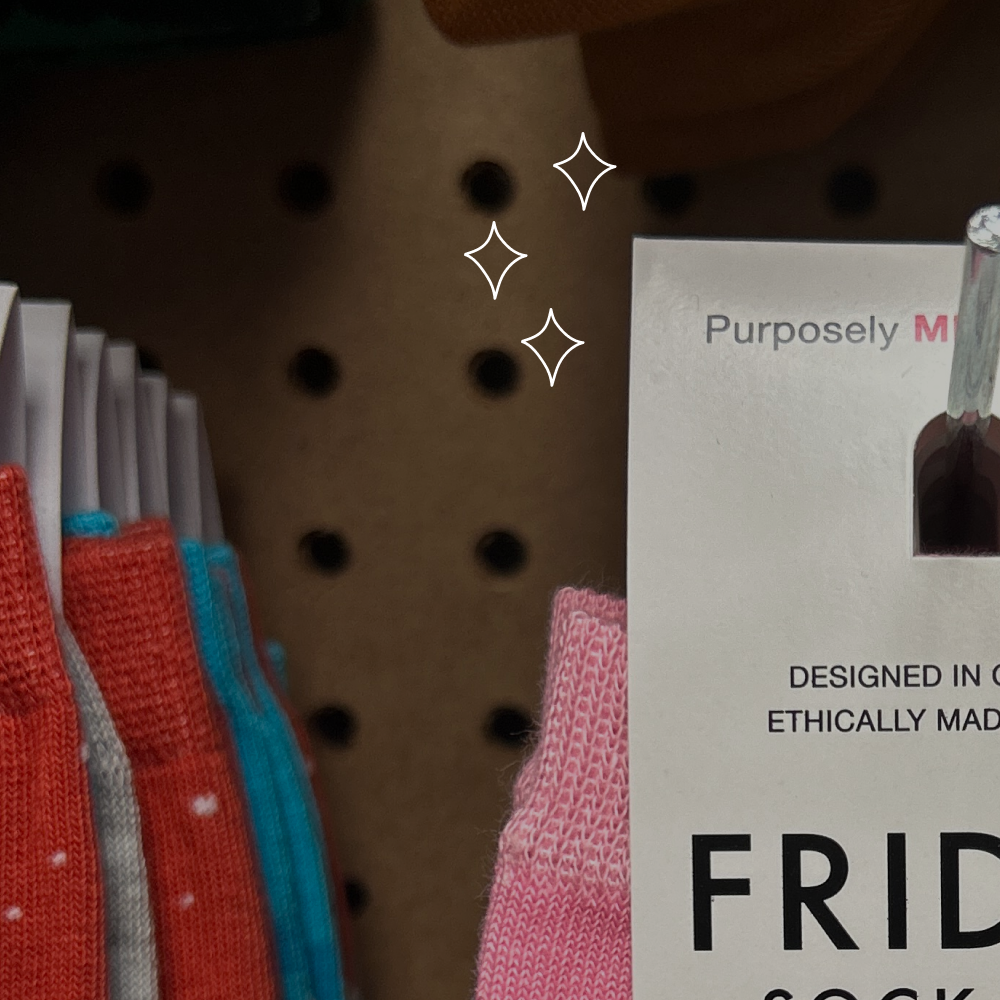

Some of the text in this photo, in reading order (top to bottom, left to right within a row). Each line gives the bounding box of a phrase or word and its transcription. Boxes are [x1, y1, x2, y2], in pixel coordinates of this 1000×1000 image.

[707, 314, 899, 350] Purposely
[790, 664, 942, 688] DESIGNED
[954, 664, 980, 687] IN
[768, 709, 926, 733] ETHICALLY
